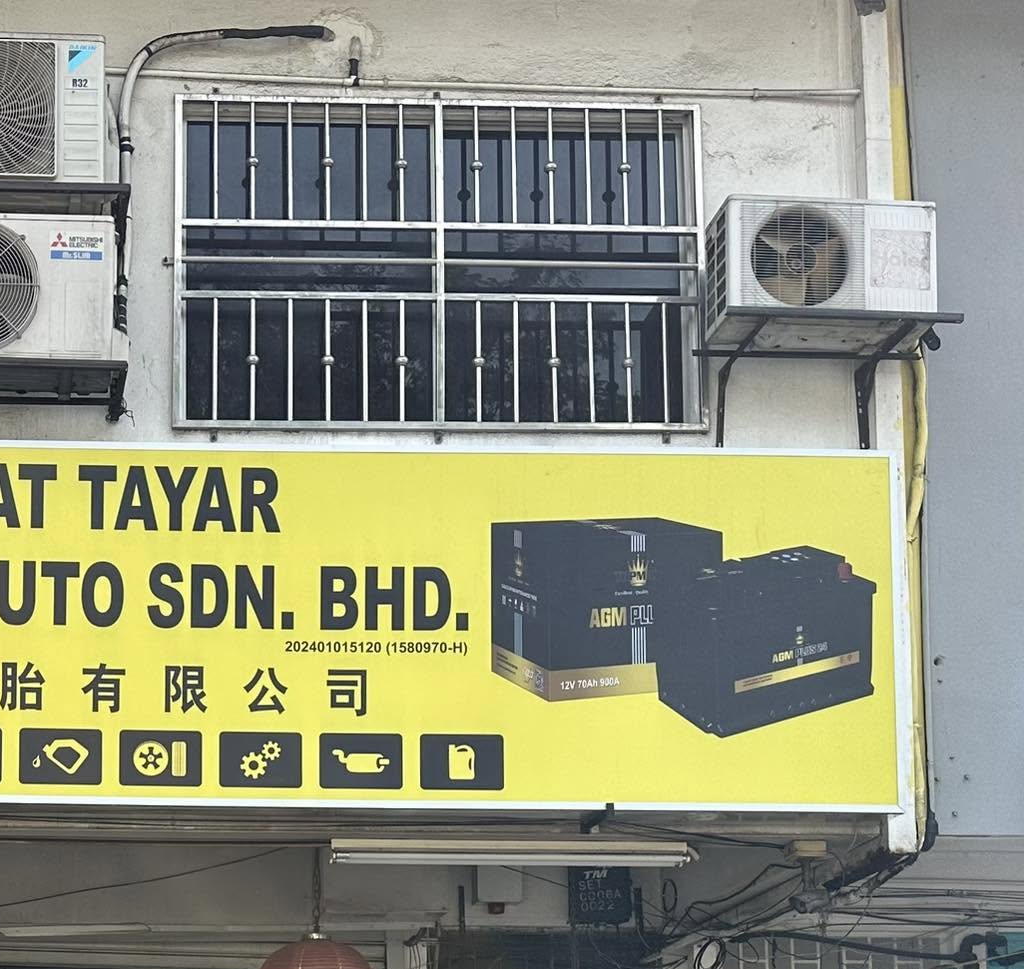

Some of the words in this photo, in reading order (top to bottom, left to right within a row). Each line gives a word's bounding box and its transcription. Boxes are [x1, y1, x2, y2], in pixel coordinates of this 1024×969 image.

[78, 464, 281, 534] TAYAR
[147, 562, 295, 631] SDN.
[319, 565, 469, 631] BHD.
[589, 606, 627, 629] AGM
[285, 640, 382, 653] 202401015120
[386, 641, 468, 656] (1580970-H)
[772, 649, 794, 664] AGM
[560, 680, 576, 691] 12V
[577, 678, 598, 689] 70Ah
[583, 869, 609, 880] TM
